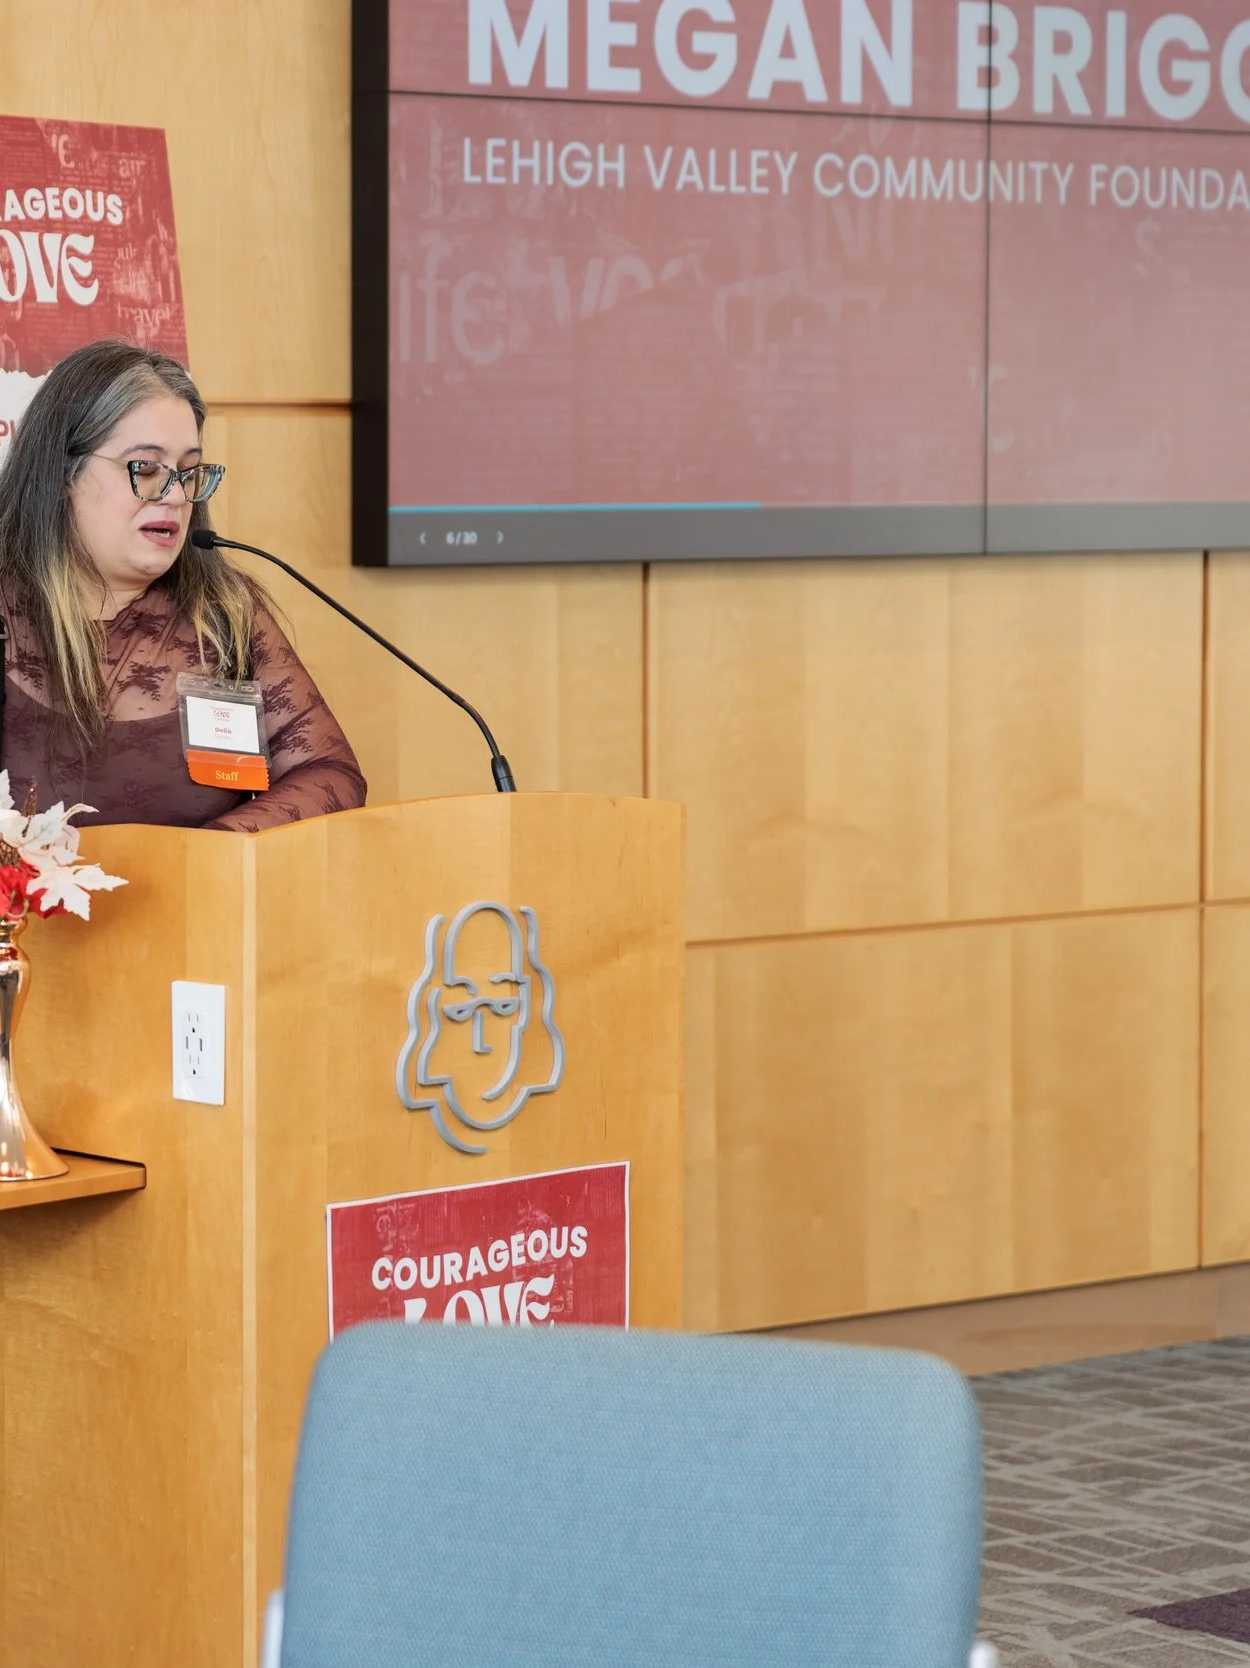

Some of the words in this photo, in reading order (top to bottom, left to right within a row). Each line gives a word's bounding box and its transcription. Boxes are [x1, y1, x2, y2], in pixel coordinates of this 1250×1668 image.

[468, 0, 913, 107] MEGAN
[464, 136, 625, 189] LEHIGH
[644, 144, 798, 196] VALLEY
[814, 152, 1075, 205] COMMUNITY
[1090, 162, 1250, 211] FOUNDA
[215, 769, 239, 781] Staff
[371, 1225, 588, 1290] COURAGEOUS
